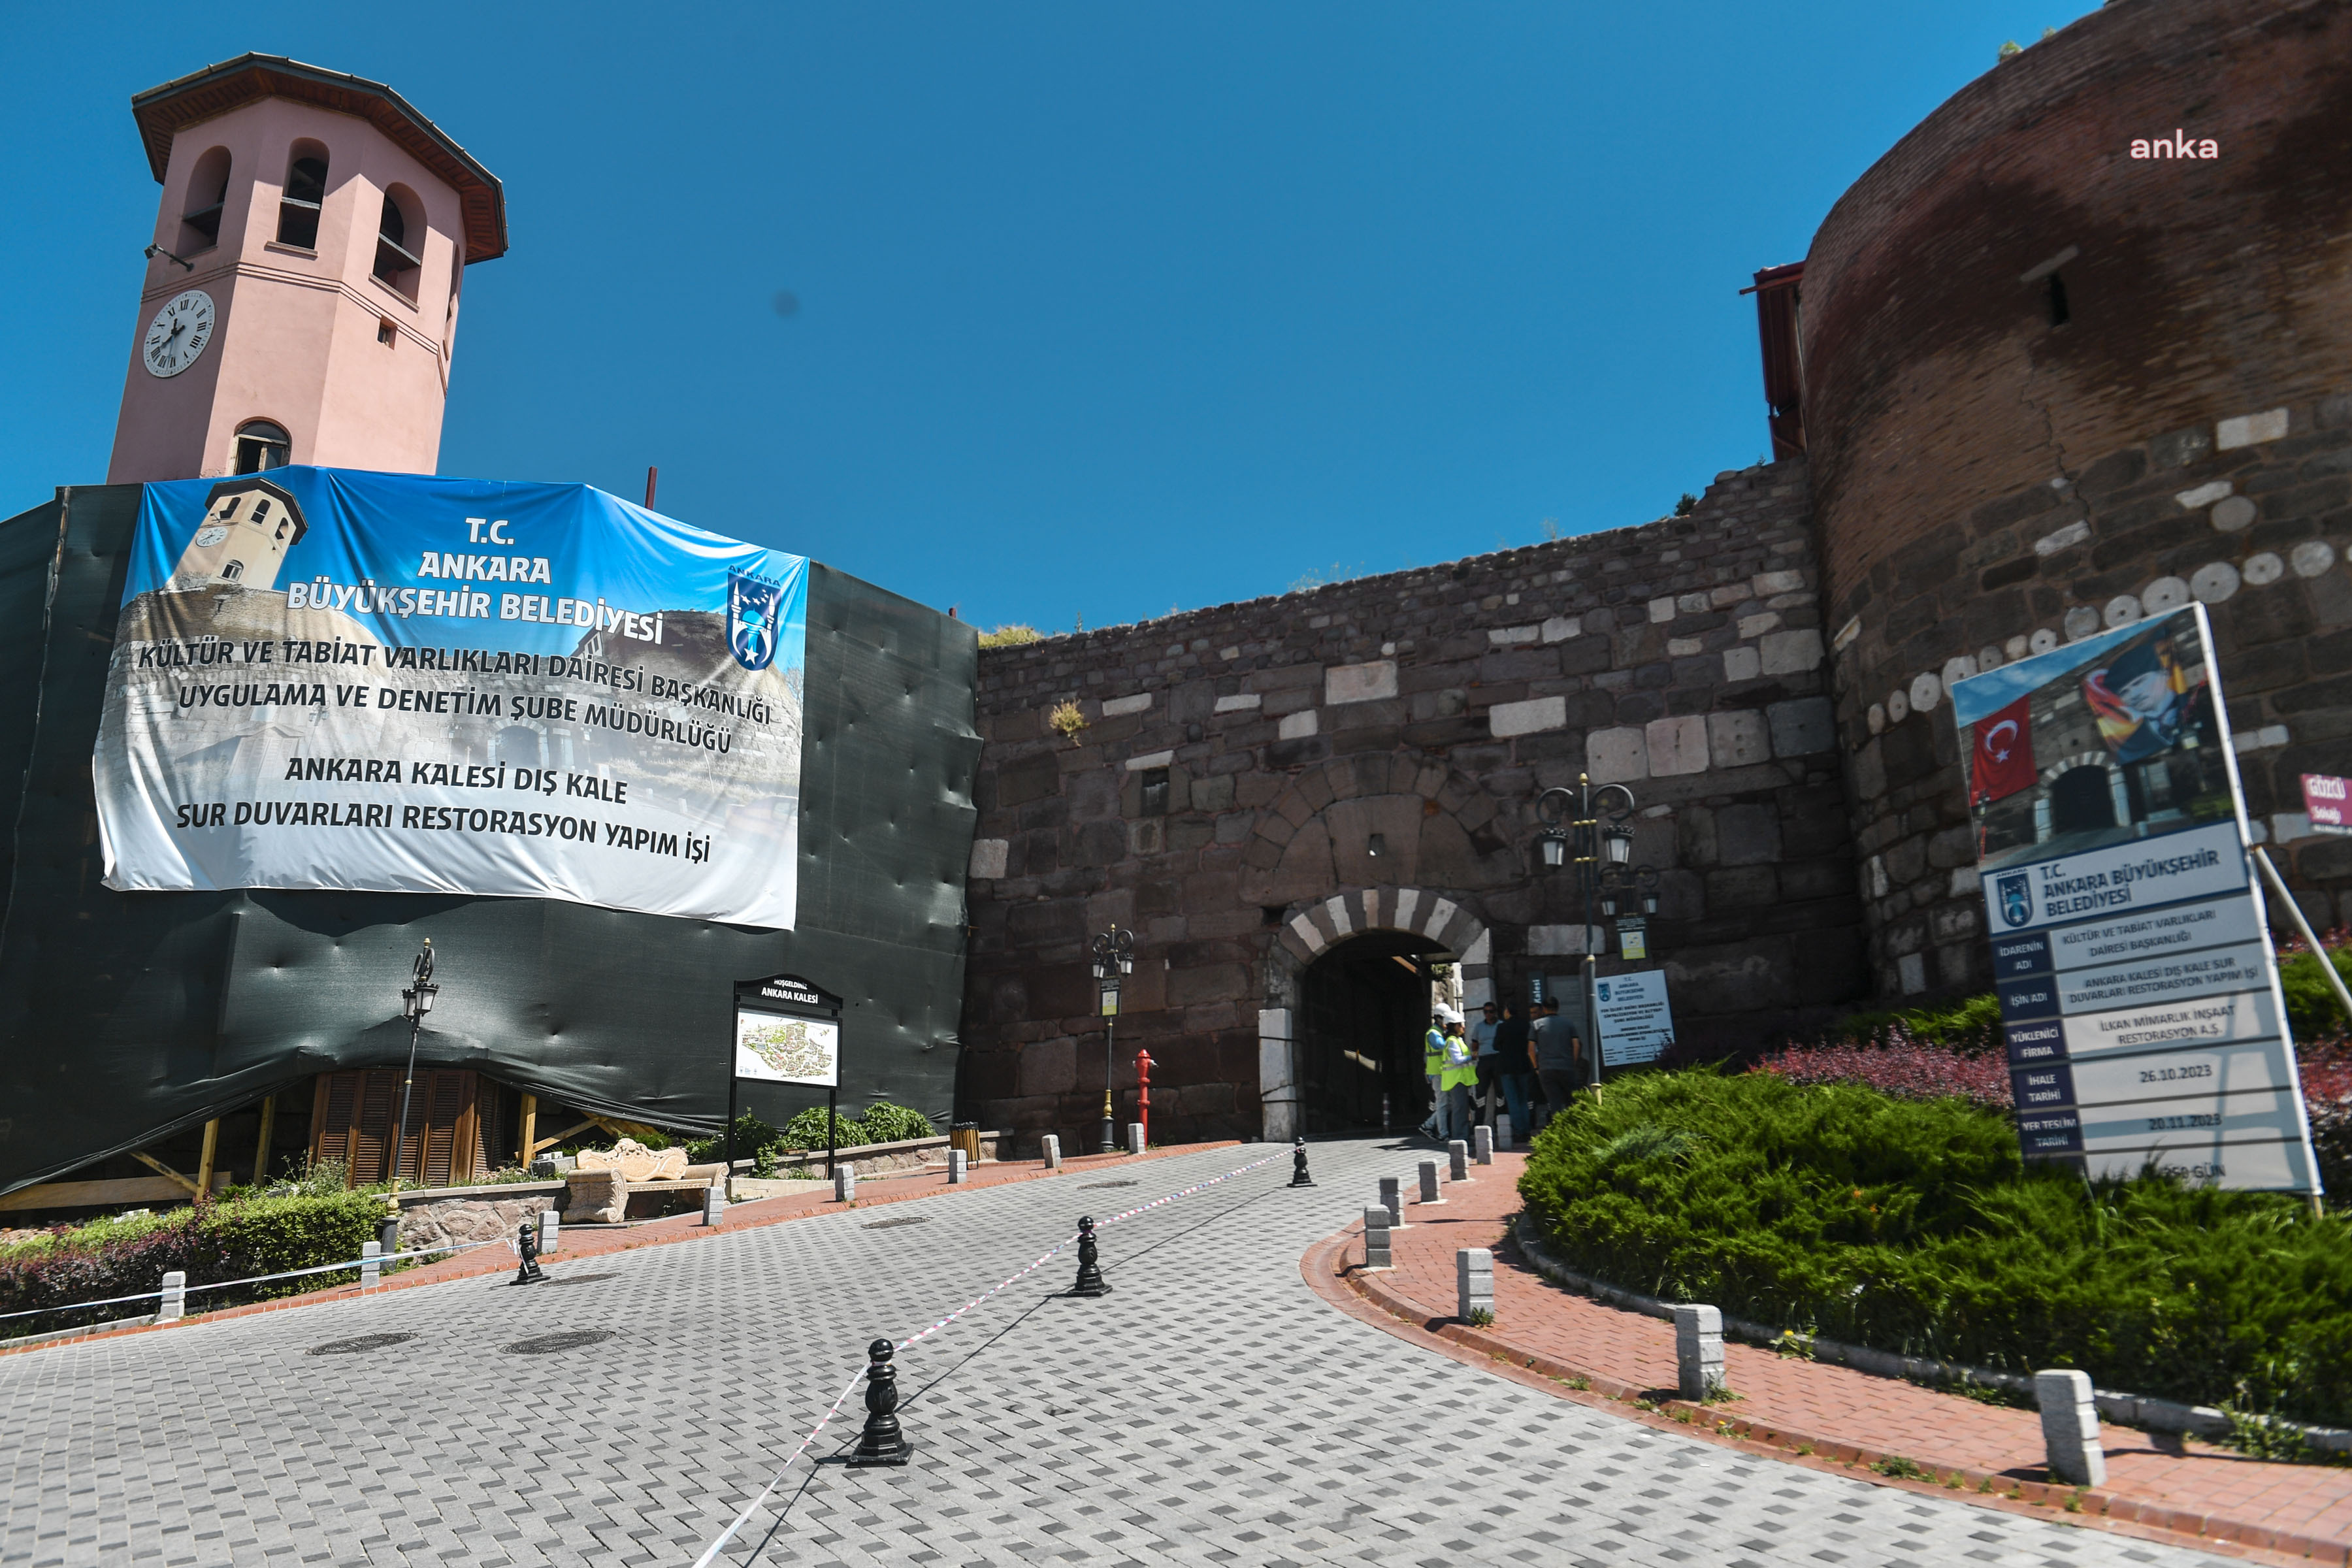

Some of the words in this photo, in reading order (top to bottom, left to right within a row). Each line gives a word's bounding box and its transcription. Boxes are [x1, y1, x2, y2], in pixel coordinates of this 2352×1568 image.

[465, 517, 515, 545] T.C.
[417, 551, 551, 585] ANKARA
[728, 564, 781, 587] ANKARA
[286, 575, 490, 619] BÜYÜKŞEHİR
[499, 592, 663, 645] BELEDİYESİ
[138, 636, 234, 668] KÜLTÜR
[243, 640, 273, 663] VE
[282, 636, 377, 666] TABİAT
[384, 645, 539, 676] VARLIKLARI
[548, 653, 643, 693] DAİRESİ
[650, 676, 770, 725] BAŞKANLIĞI
[178, 684, 326, 709] UYGULAMA
[336, 685, 367, 708] VE
[378, 686, 502, 717] DENETİM
[510, 696, 577, 723] ŞUBE
[583, 705, 732, 754] MÜDÜRLÜĞÜ
[285, 757, 402, 783] ANKARA
[412, 760, 506, 789] KALESİ
[514, 767, 557, 797] DIŞ
[566, 774, 628, 804] KALE
[176, 804, 225, 828] SUR
[233, 802, 392, 828] DUVARLARI
[402, 805, 597, 843] RESTORASYON
[605, 823, 678, 857] YAPIM
[685, 831, 711, 864] İŞİ
[1996, 868, 2029, 878] ANKARA
[2040, 864, 2066, 880] T.C.
[2044, 873, 2110, 899] ANKARA
[2111, 849, 2220, 885] BÜYÜKŞEHİR
[2046, 884, 2132, 917] BELEDİYESİ
[2063, 930, 2100, 944] KÜLTÜR
[2103, 928, 2116, 938] VE
[2117, 920, 2153, 936] TABİAT
[2156, 909, 2215, 928] VARLIKLARI
[2000, 941, 2044, 957] İDARENİN
[2090, 941, 2128, 956] DAİRESİ
[2131, 930, 2191, 951] BAŞKANLIĞI
[2016, 960, 2033, 970] ADI
[2085, 974, 2126, 988] ANKARA
[2128, 966, 2162, 981] KALESİ
[2164, 965, 2182, 976] DIŞ
[2183, 961, 2212, 972] KALE
[2213, 957, 2236, 970] SUR
[774, 978, 808, 990] HOŞGELDİNİZ
[2070, 987, 2127, 1004] DUVARLARI
[2128, 976, 2204, 994] RESTORASYON
[2206, 970, 2243, 983] YAPIM
[2245, 966, 2259, 979] İŞİ
[761, 987, 792, 1001] ANKARA
[794, 992, 819, 1004] KALESİ
[2011, 994, 2029, 1007] İŞİN
[2032, 992, 2048, 1003] ADI
[2100, 1020, 2131, 1032] İLKAN
[2133, 1011, 2191, 1028] MİMARLIK
[2193, 1005, 2236, 1020] İNŞAAT
[2010, 1026, 2059, 1043] YÜKLENİCİ
[2118, 1026, 2198, 1045] RESTORASYON
[2200, 1023, 2223, 1035] A.Ş.
[2023, 1046, 2054, 1058] FİRMA
[2029, 1074, 2057, 1086] İHALE
[2140, 1064, 2213, 1083] 26.10.2023
[2028, 1089, 2061, 1103] TARİHİ
[2022, 1121, 2041, 1132] YER
[2042, 1118, 2077, 1130] TESLİM
[2149, 1113, 2223, 1130] 20.11.2023
[2036, 1134, 2068, 1147] TARİHİ
